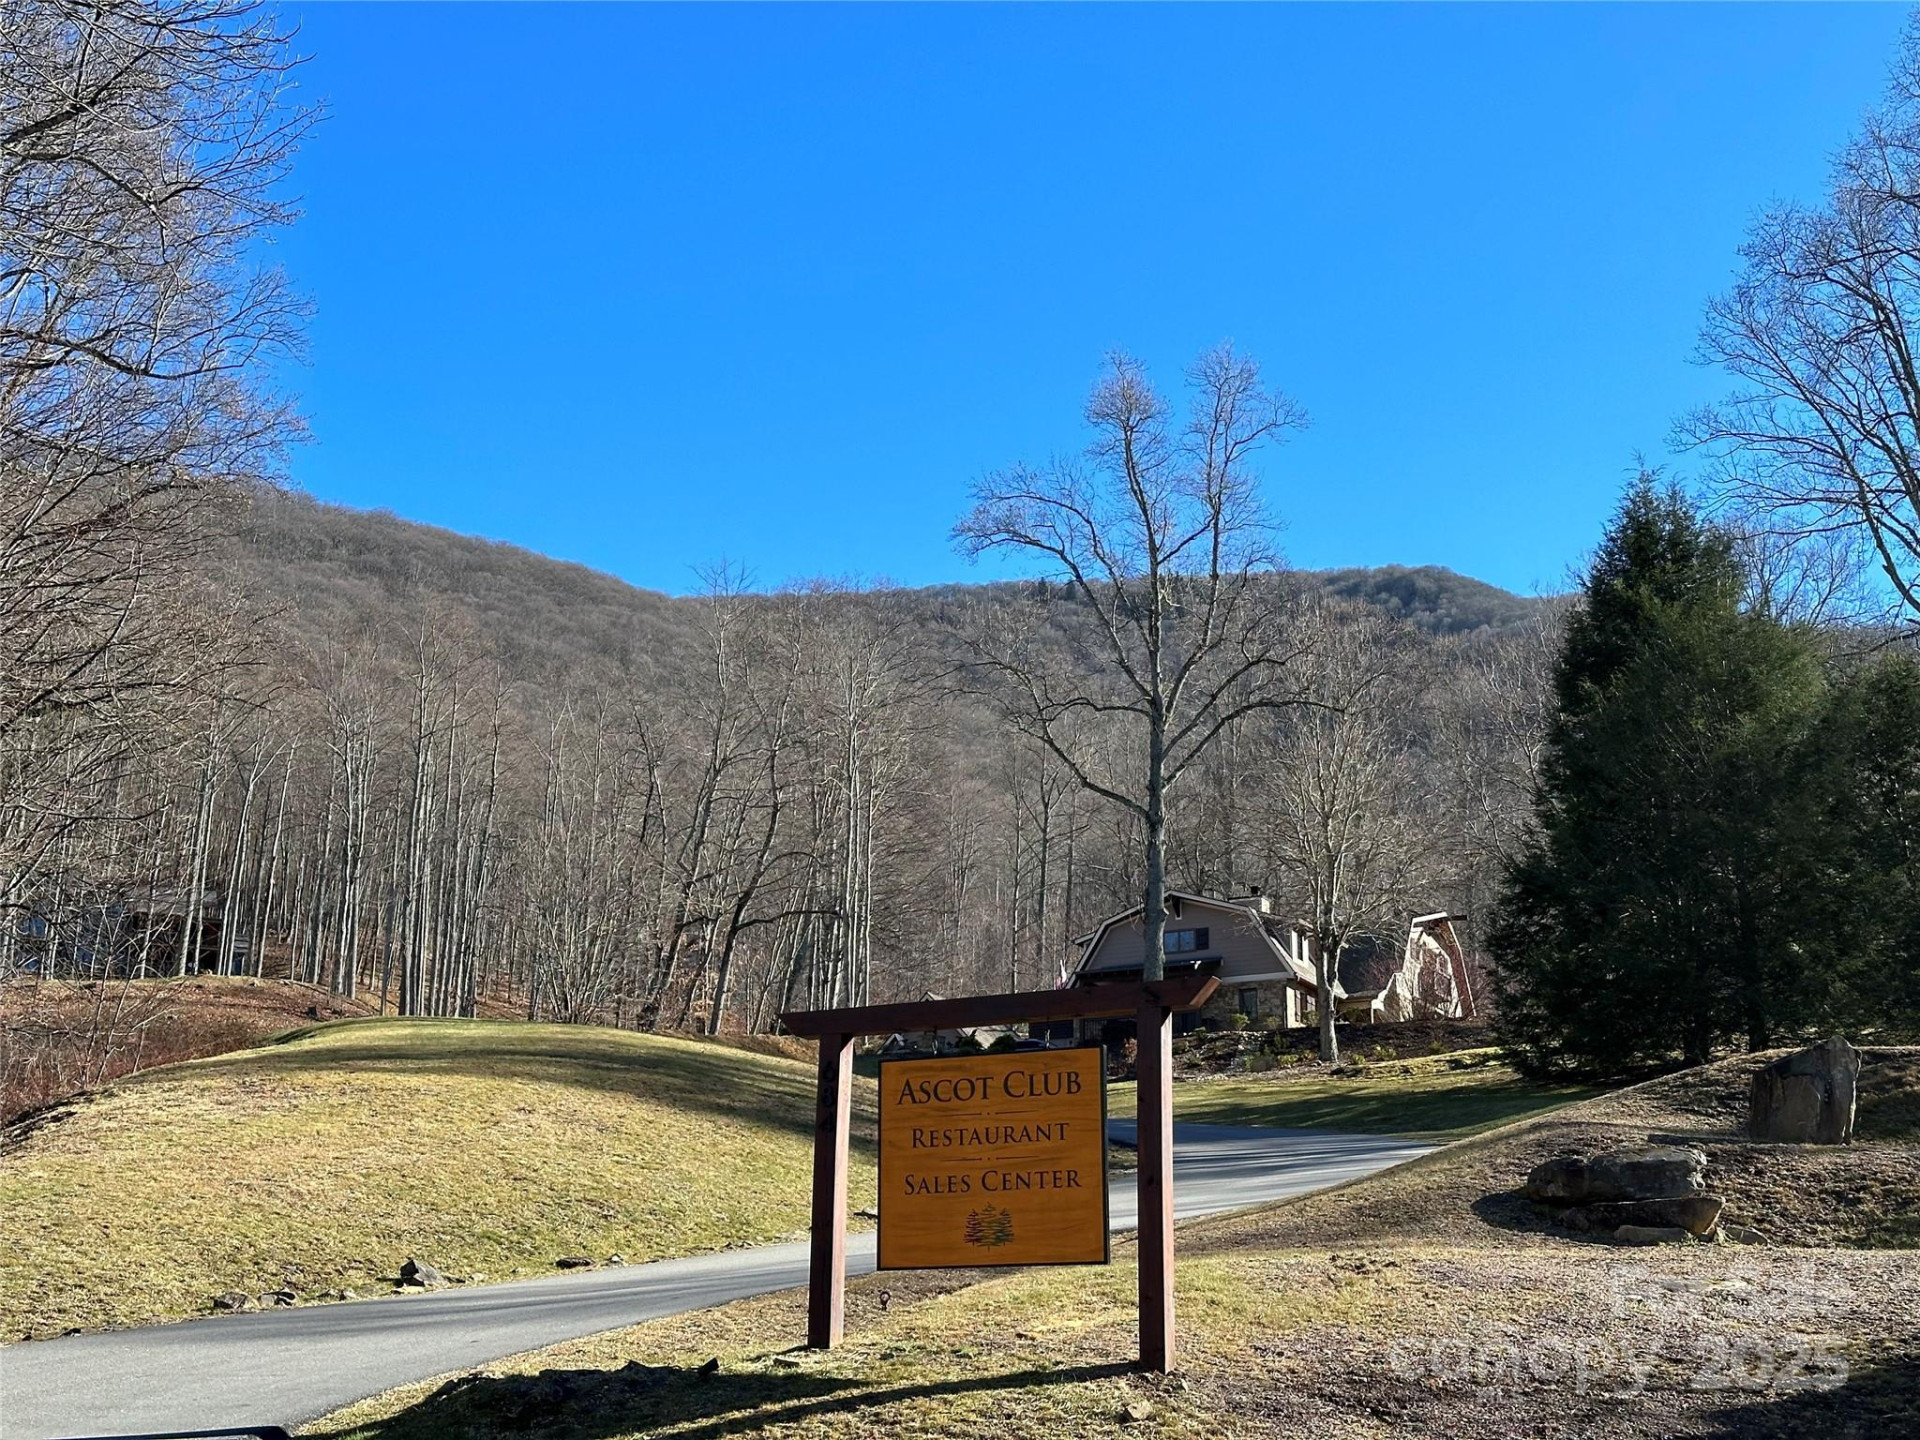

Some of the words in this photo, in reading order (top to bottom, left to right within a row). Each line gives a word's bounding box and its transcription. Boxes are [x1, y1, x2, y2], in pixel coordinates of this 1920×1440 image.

[896, 1076, 994, 1106] ASCOT
[1003, 1070, 1082, 1098] CLUB
[912, 1122, 1070, 1149] RESTAURANT
[904, 1173, 971, 1196] SALES
[981, 1169, 1082, 1192] CENTER
